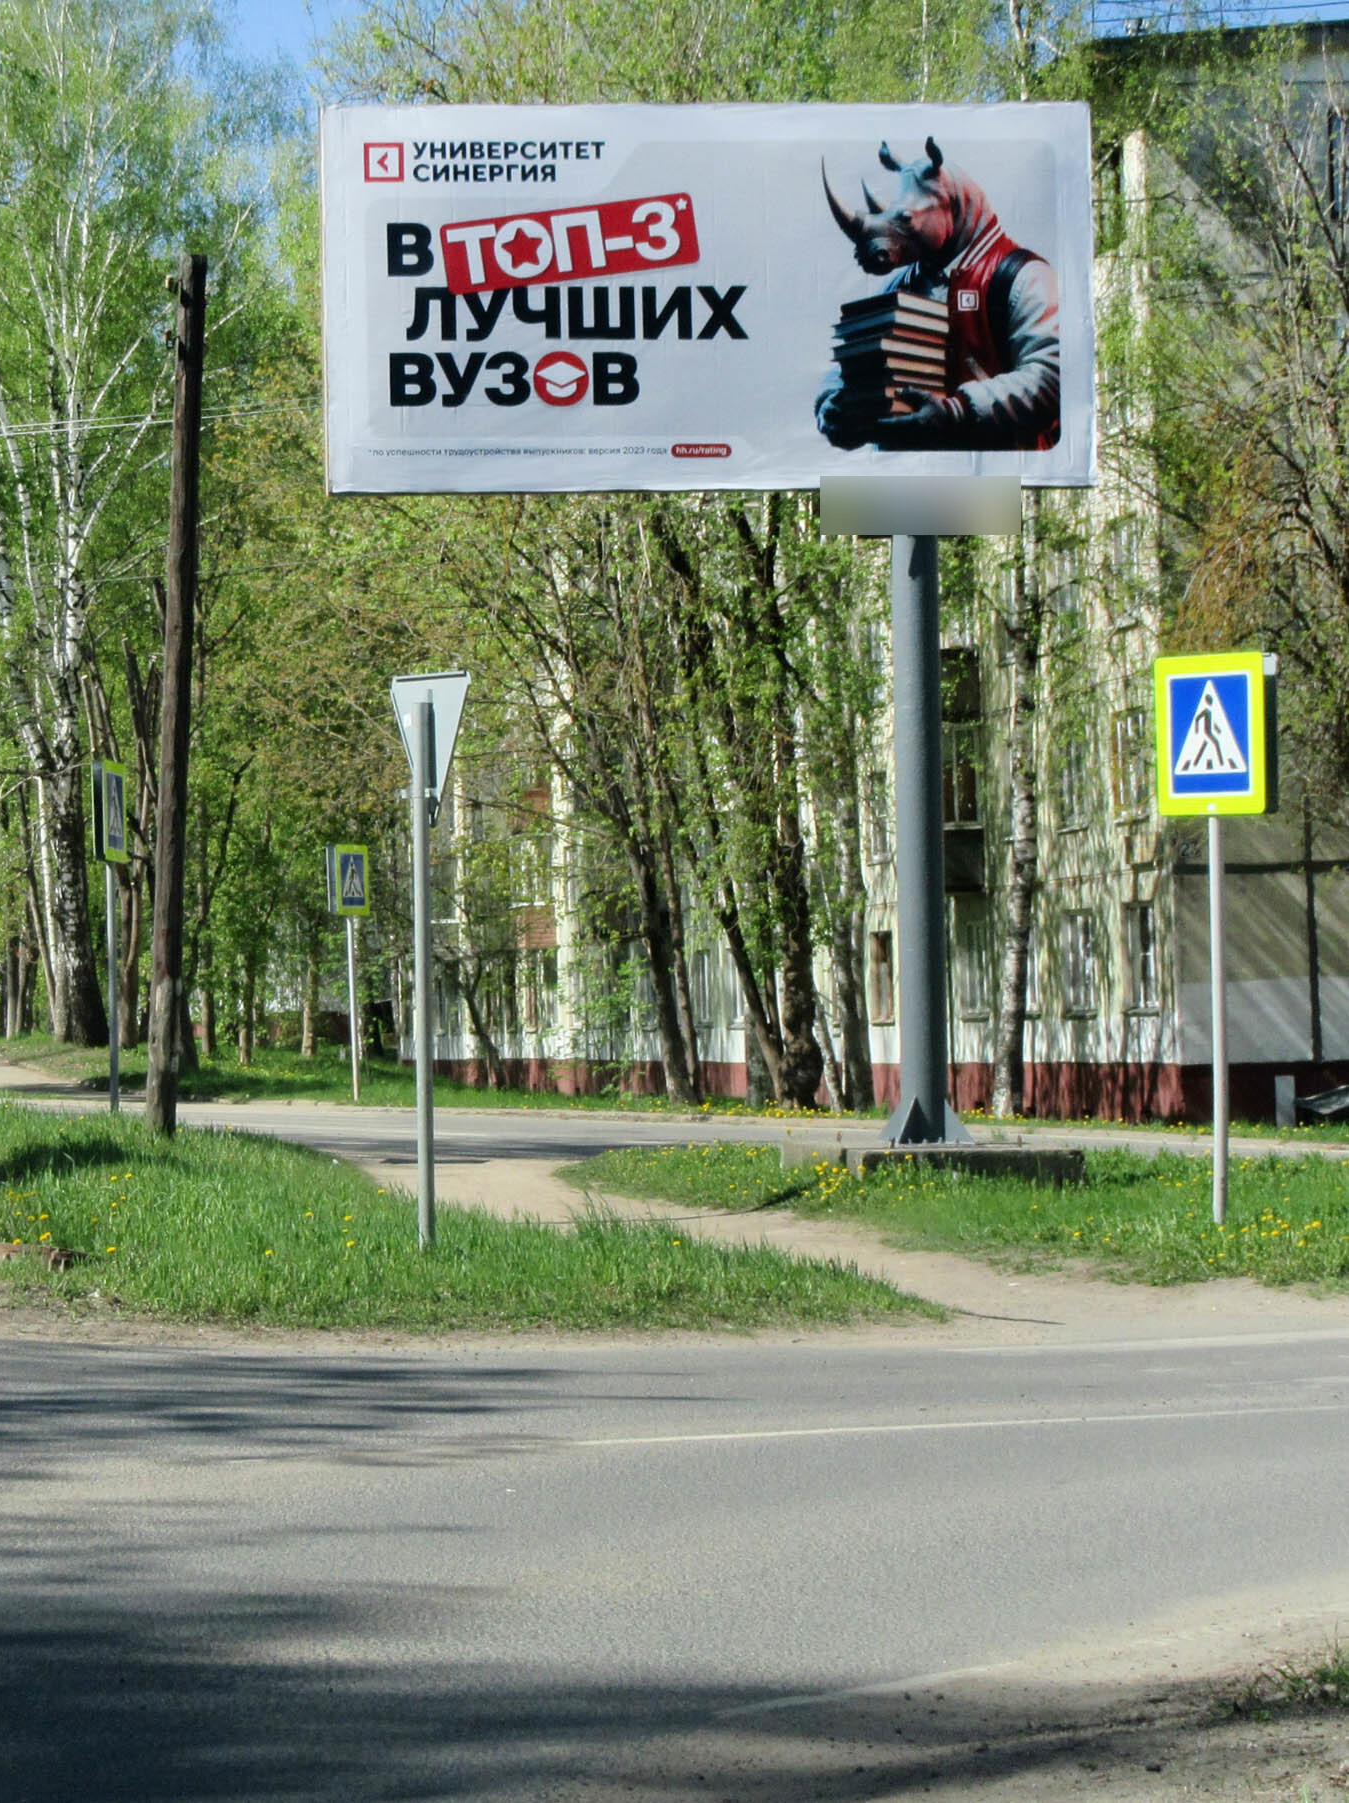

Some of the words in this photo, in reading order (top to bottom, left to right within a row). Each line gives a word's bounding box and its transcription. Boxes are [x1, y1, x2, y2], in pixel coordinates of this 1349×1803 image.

[413, 141, 605, 160] УНИВЕРСИТЕТ
[413, 164, 557, 183] СИНЕРГИЯ
[386, 222, 435, 278] В
[405, 285, 749, 342] ЛУЧШИХ
[389, 351, 640, 407] ВУЗОВ
[386, 448, 441, 458] успешности
[623, 446, 645, 455] 2023
